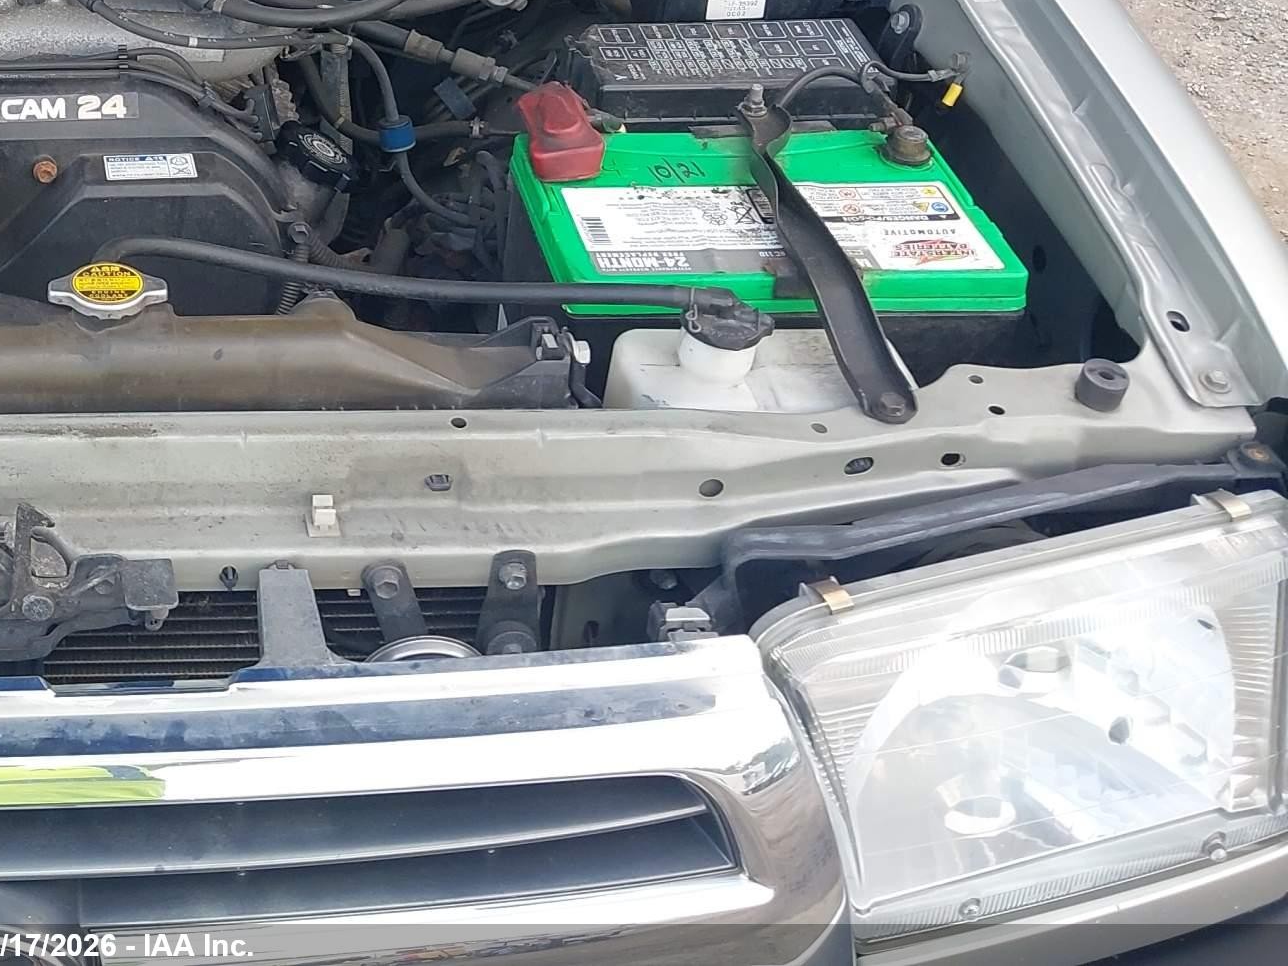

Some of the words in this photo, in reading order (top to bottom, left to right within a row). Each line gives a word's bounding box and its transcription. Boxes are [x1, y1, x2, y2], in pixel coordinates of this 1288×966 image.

[0, 97, 67, 121] CAM
[77, 94, 128, 120] 24
[883, 228, 957, 236] AUTOMOTIVE
[895, 243, 968, 251] BATTERIES
[892, 249, 976, 258] INTERSTATE
[595, 256, 690, 268] 24-MONTH
